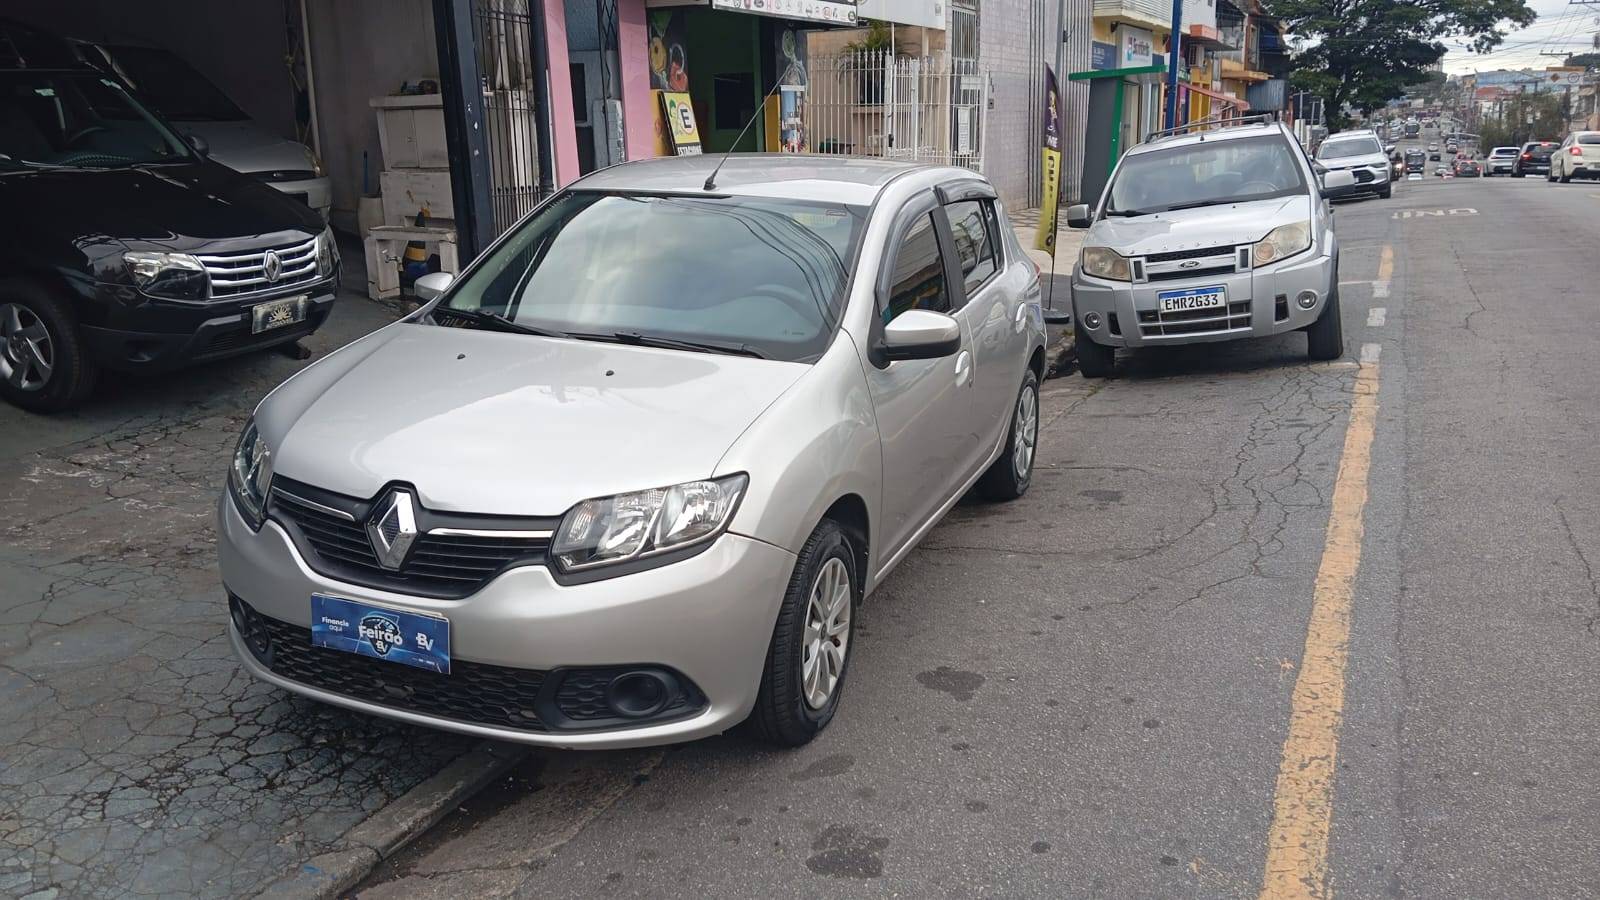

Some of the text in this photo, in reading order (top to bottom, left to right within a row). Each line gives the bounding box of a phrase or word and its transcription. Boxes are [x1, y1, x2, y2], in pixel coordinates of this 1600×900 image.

[680, 109, 692, 128] E
[1165, 294, 1218, 310] EMR2G33
[359, 625, 403, 645] Feirão
[416, 633, 433, 650] BV
